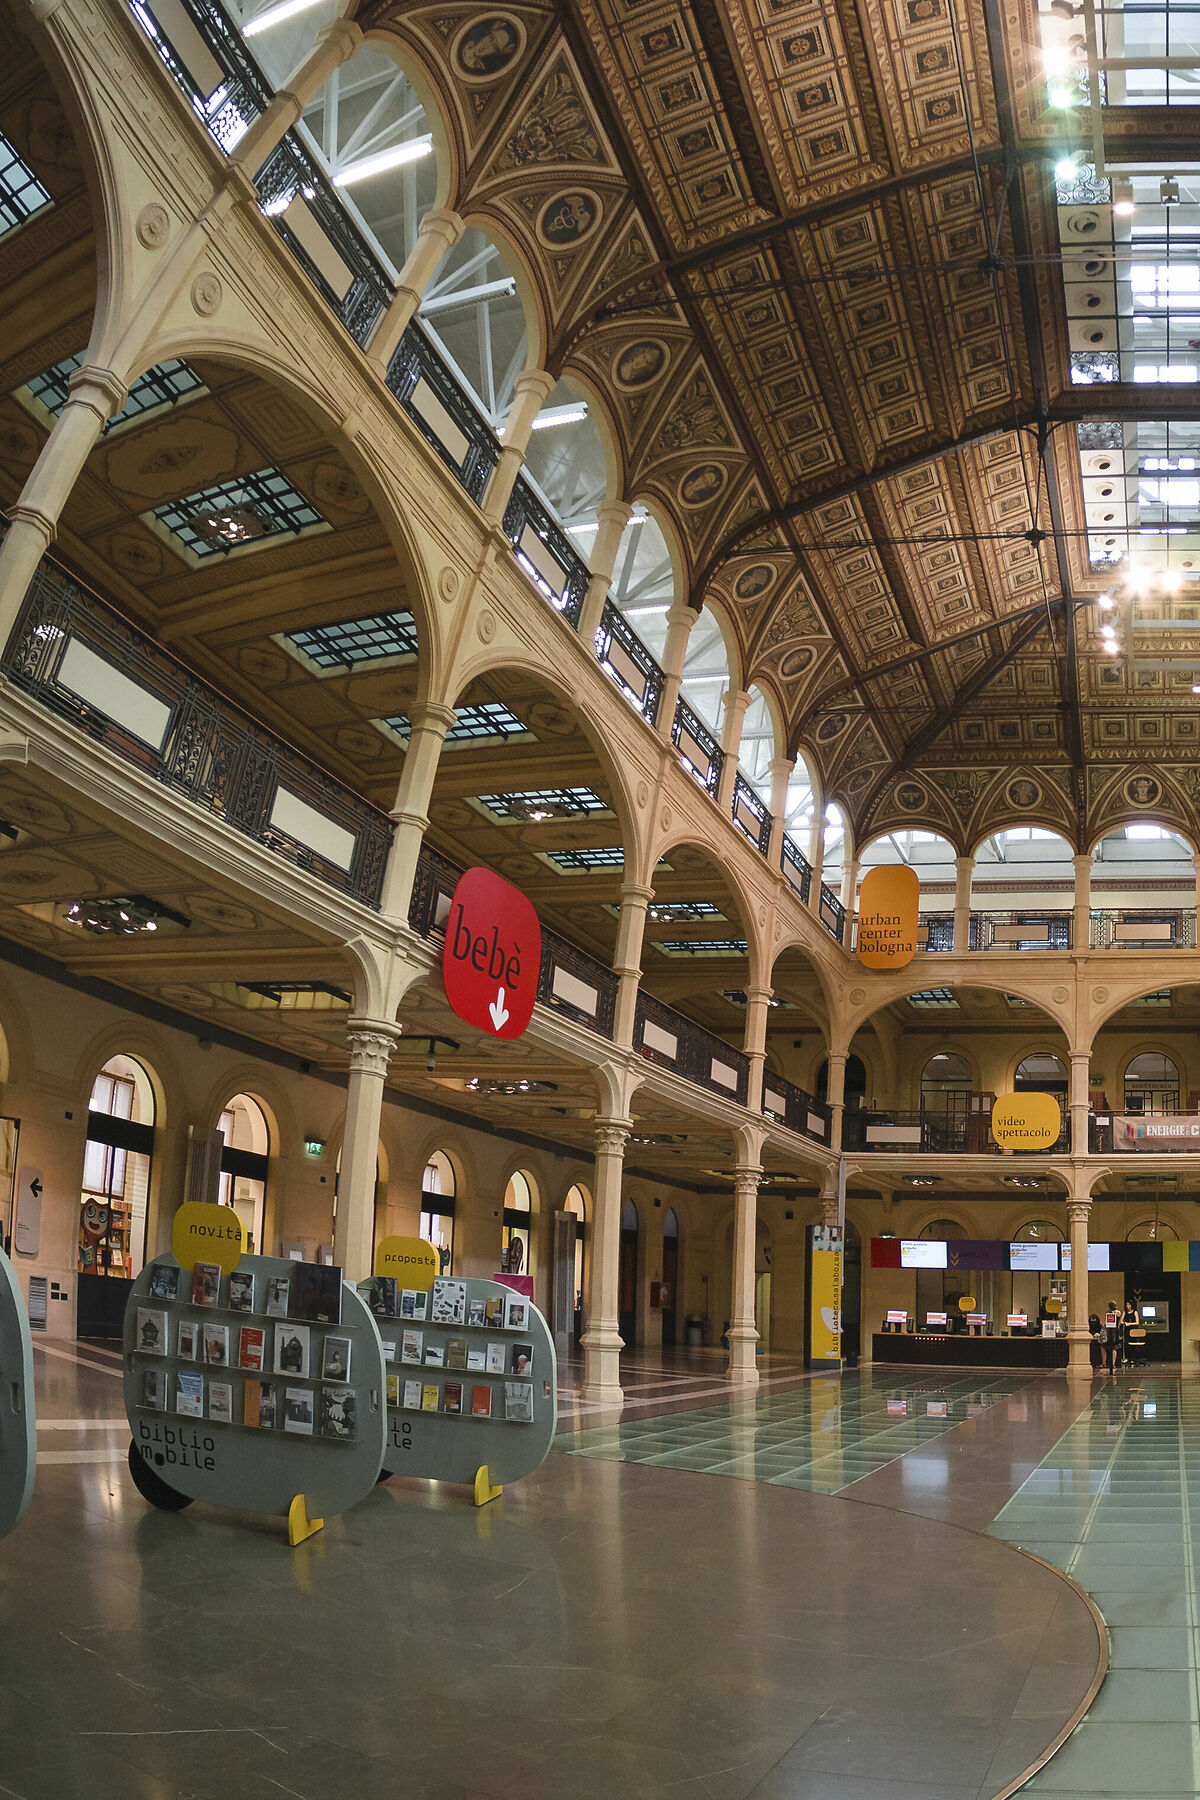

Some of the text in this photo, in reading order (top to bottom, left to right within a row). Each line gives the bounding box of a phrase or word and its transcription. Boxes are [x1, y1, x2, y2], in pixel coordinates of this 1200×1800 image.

[861, 912, 901, 926] urban
[859, 929, 903, 940] center
[452, 903, 521, 990] bebè
[859, 940, 913, 956] bologna
[997, 1115, 1026, 1126] video
[997, 1127, 1051, 1140] spettacolo
[1146, 1124, 1185, 1136] ENERGIE
[189, 1224, 242, 1241] novità
[384, 1253, 436, 1266] proposte
[139, 1420, 215, 1452] biblio
